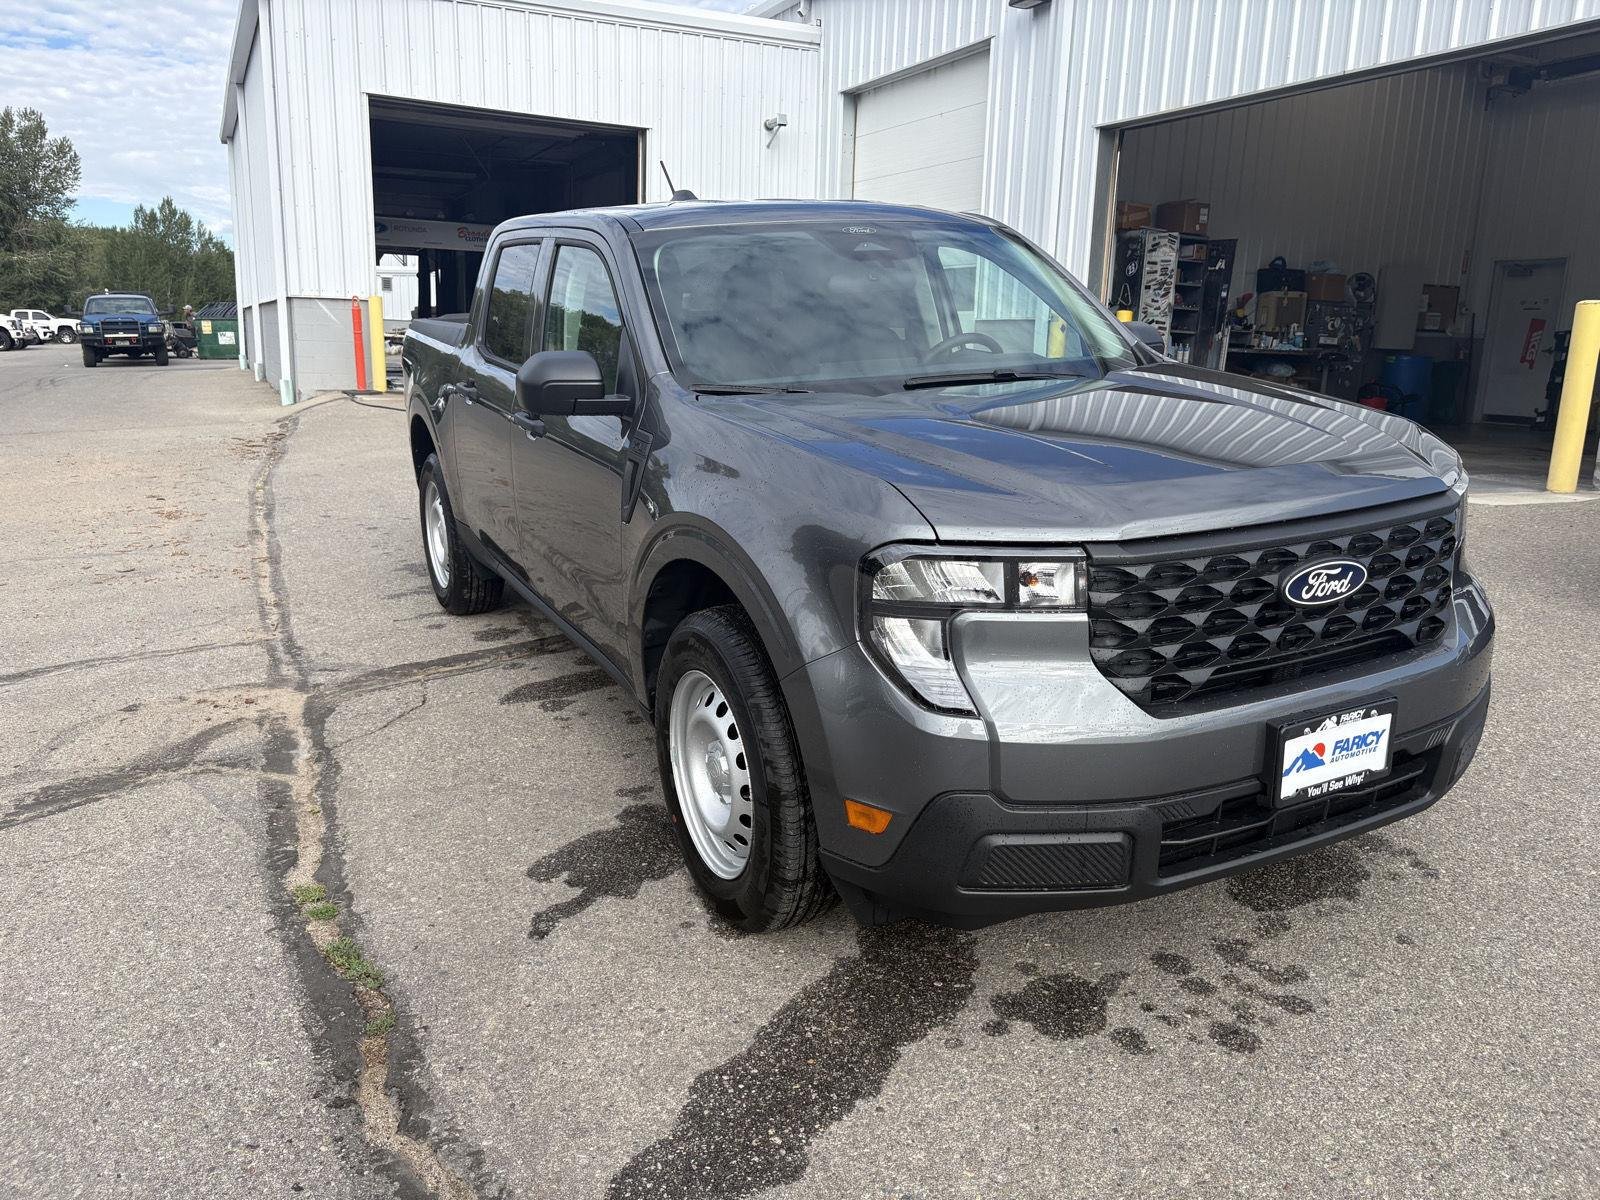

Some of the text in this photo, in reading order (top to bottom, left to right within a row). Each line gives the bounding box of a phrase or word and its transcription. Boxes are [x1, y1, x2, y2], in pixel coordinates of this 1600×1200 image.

[1301, 567, 1353, 599] Ford
[1340, 709, 1366, 723] FARICY
[1330, 746, 1378, 763] AUTOMOTIVE
[1331, 729, 1386, 756] FARICY
[1307, 771, 1365, 797] You'll See Why!
